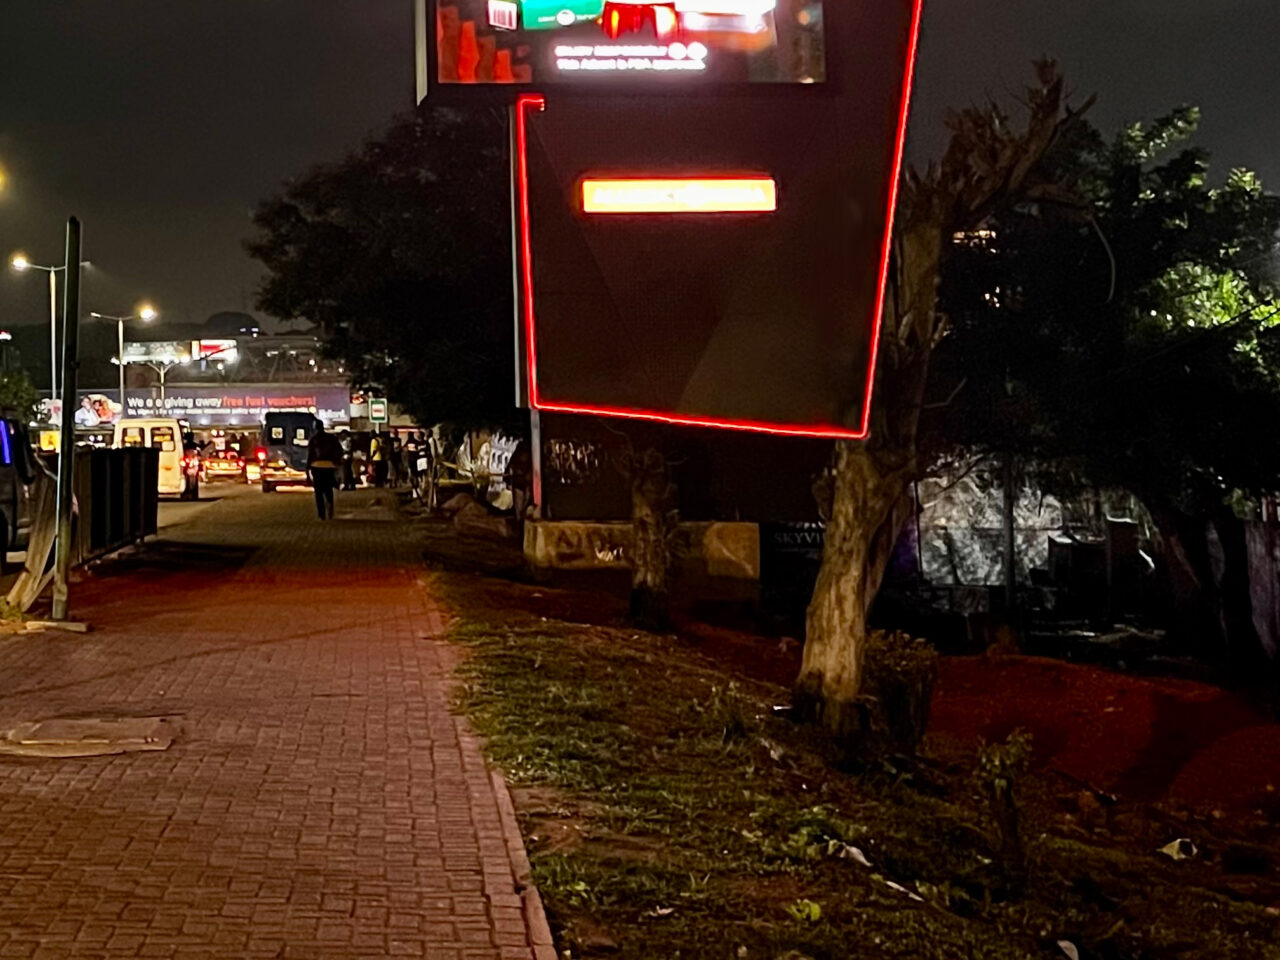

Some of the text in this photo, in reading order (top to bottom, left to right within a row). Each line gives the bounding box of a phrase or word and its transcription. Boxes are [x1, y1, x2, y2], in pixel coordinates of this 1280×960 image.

[127, 397, 144, 408] We
[146, 398, 163, 408] ae
[165, 396, 194, 409] giving
[195, 398, 222, 409] away
[222, 396, 243, 407] free
[245, 396, 264, 407] fuel
[773, 532, 821, 544] SKYVI
